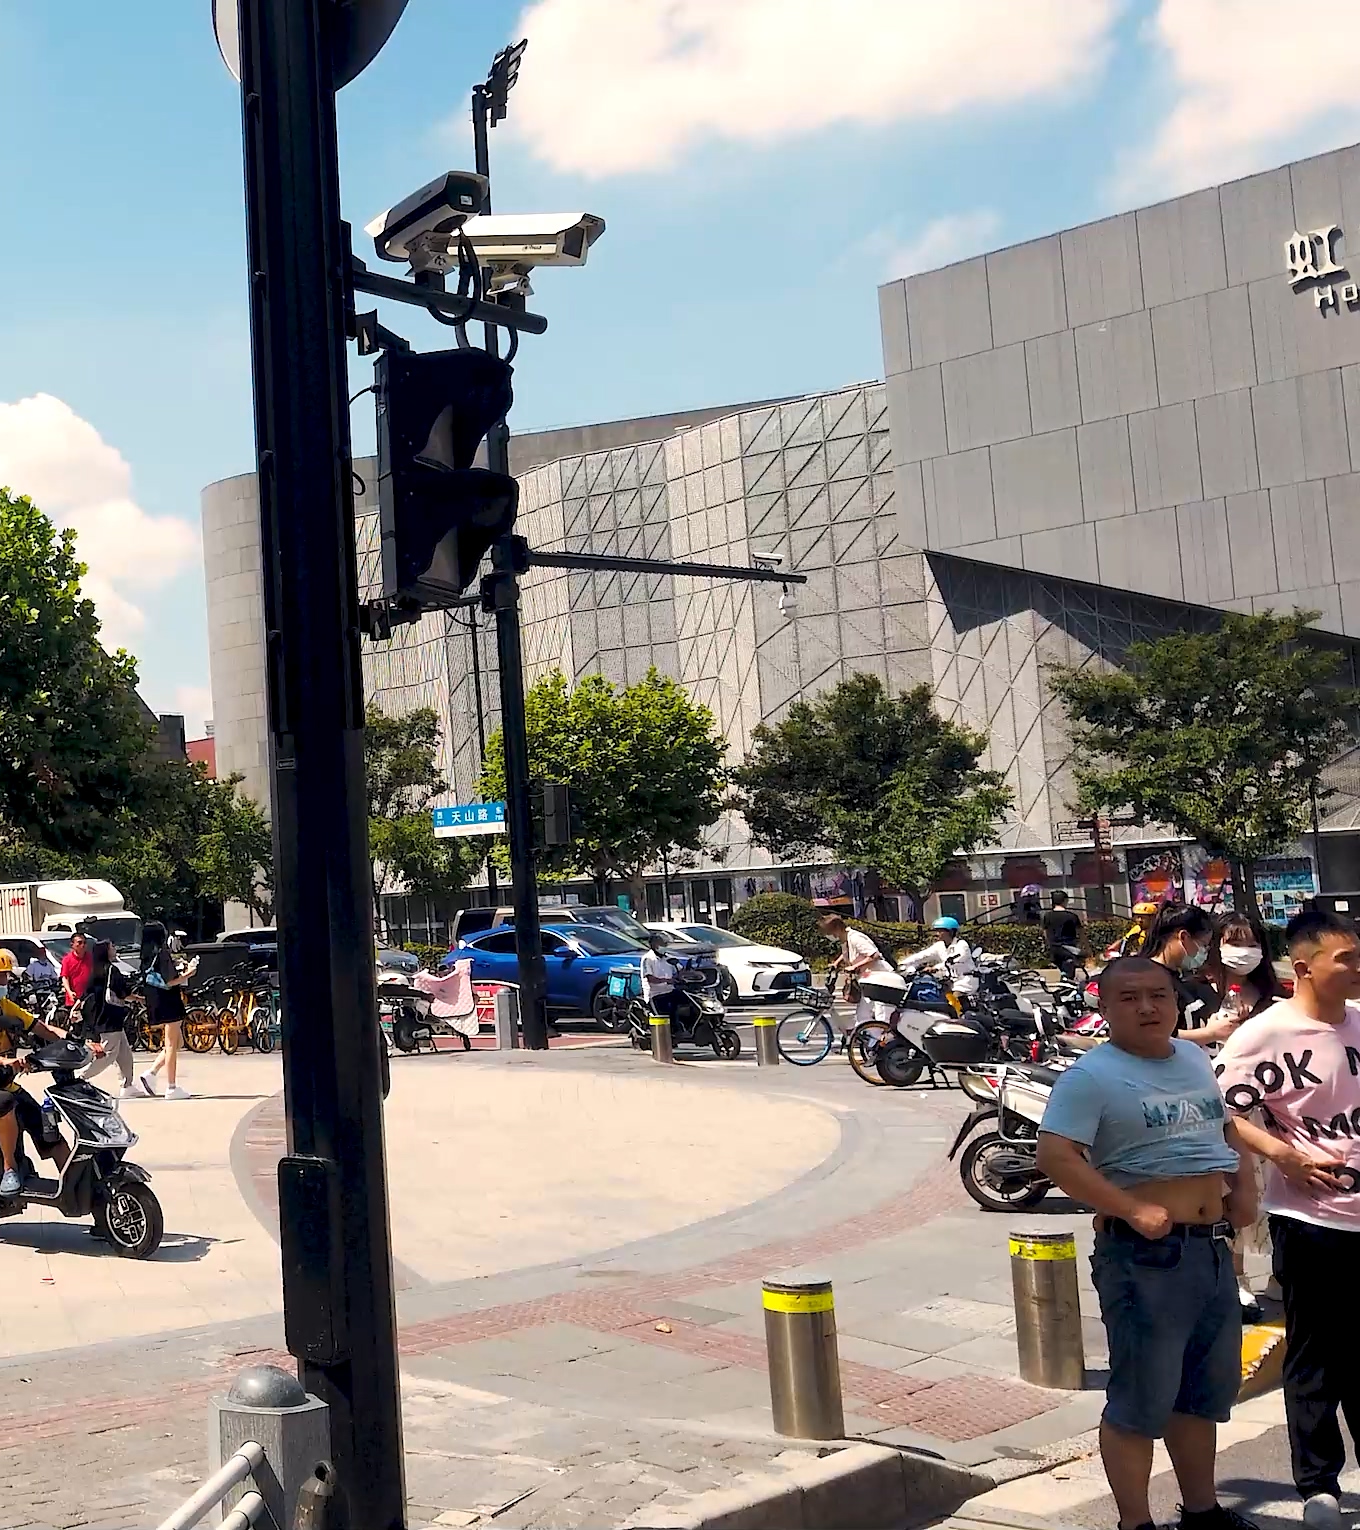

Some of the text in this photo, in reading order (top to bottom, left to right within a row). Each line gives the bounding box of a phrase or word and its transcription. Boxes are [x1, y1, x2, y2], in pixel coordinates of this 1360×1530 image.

[451, 808, 488, 824] 天山路
[8, 897, 26, 907] JMC
